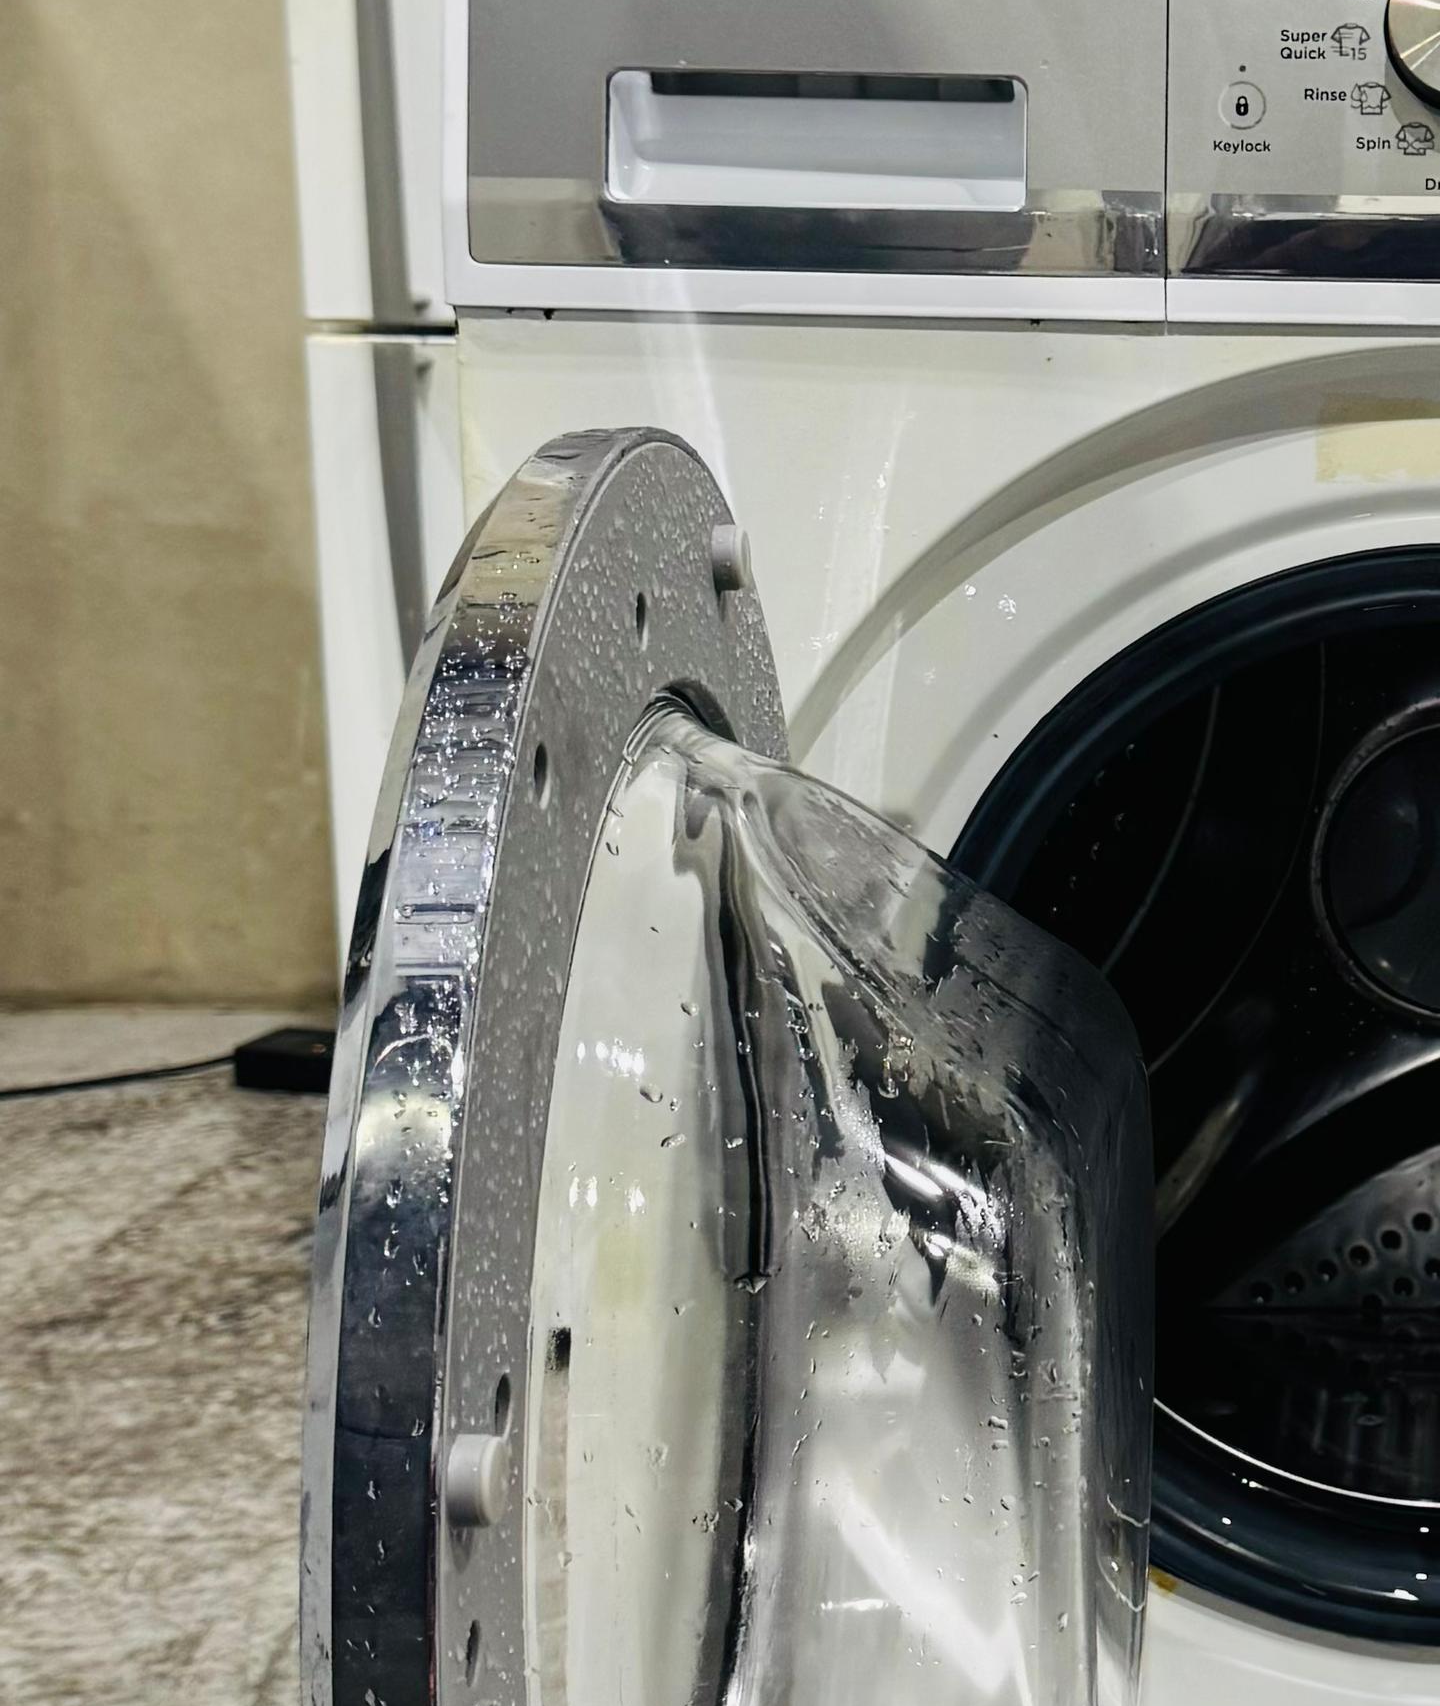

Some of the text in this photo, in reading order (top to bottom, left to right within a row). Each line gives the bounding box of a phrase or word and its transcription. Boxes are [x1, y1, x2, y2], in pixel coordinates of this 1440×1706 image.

[1281, 30, 1327, 48] Super
[1281, 47, 1325, 59] Quick
[1350, 46, 1367, 61] 15
[1305, 89, 1346, 101] Rinse
[1214, 140, 1270, 154] Keylock
[1356, 137, 1391, 151] Spin
